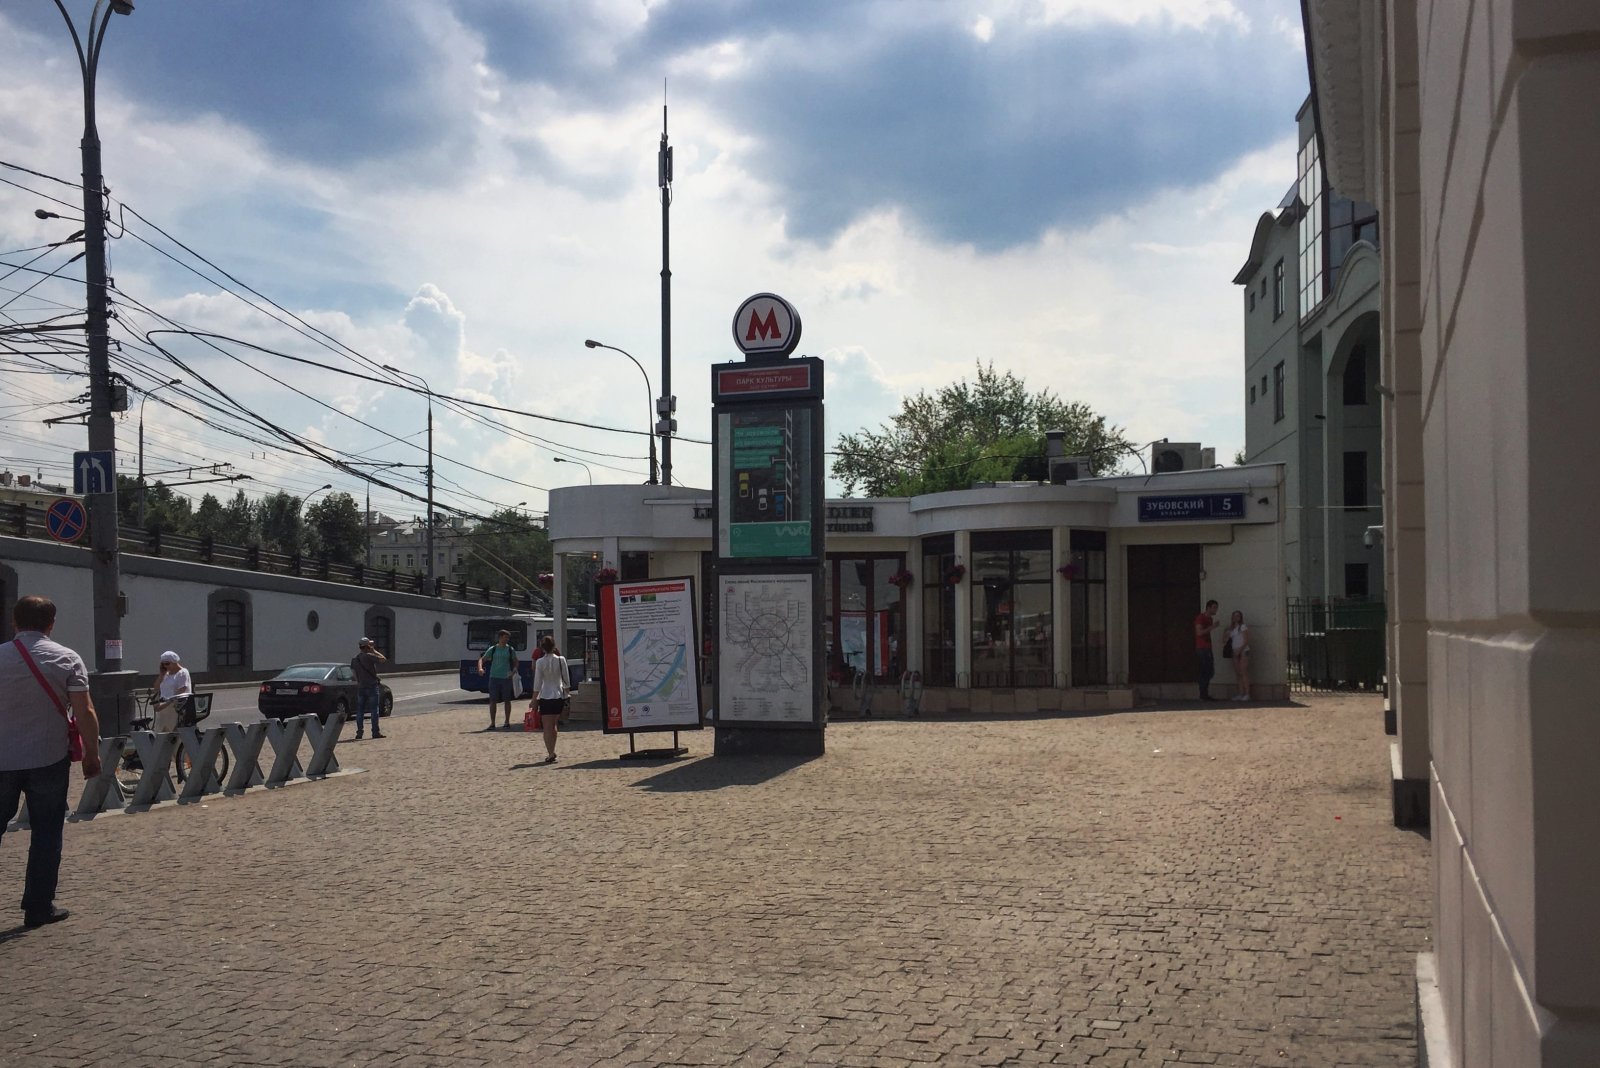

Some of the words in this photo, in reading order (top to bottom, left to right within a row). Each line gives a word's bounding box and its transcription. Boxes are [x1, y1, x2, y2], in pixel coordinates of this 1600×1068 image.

[746, 306, 781, 341] М
[736, 377, 754, 385] ПАРК
[756, 375, 792, 384] КУЛЬТУРЫ
[1146, 499, 1204, 510] ЗУБОВСКИЙ
[1222, 498, 1232, 510] 5
[827, 507, 874, 518] DIEN
